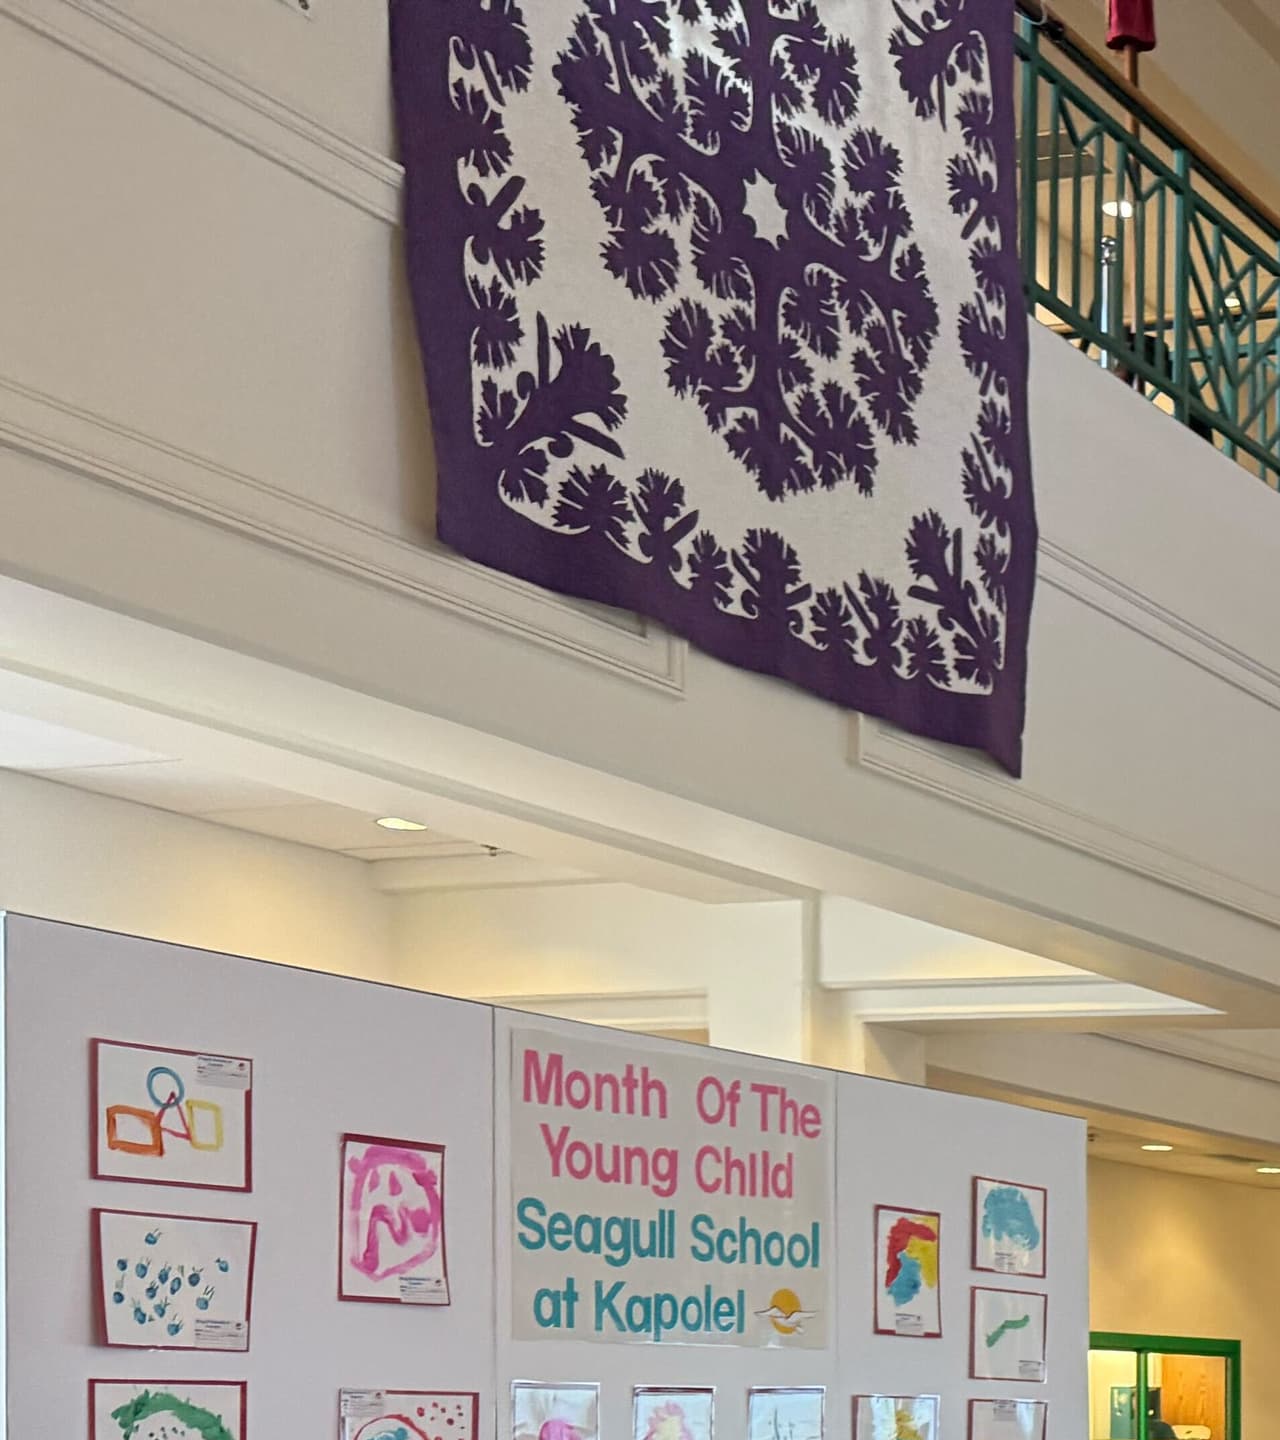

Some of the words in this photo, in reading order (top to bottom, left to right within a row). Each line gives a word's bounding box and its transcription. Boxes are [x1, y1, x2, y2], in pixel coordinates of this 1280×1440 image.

[523, 1049, 668, 1119] Month
[696, 1075, 741, 1127] Of
[751, 1083, 822, 1138] The
[540, 1123, 679, 1197] Young
[516, 1197, 676, 1268] Seagull
[690, 1213, 820, 1268] School
[533, 1277, 579, 1329] at
